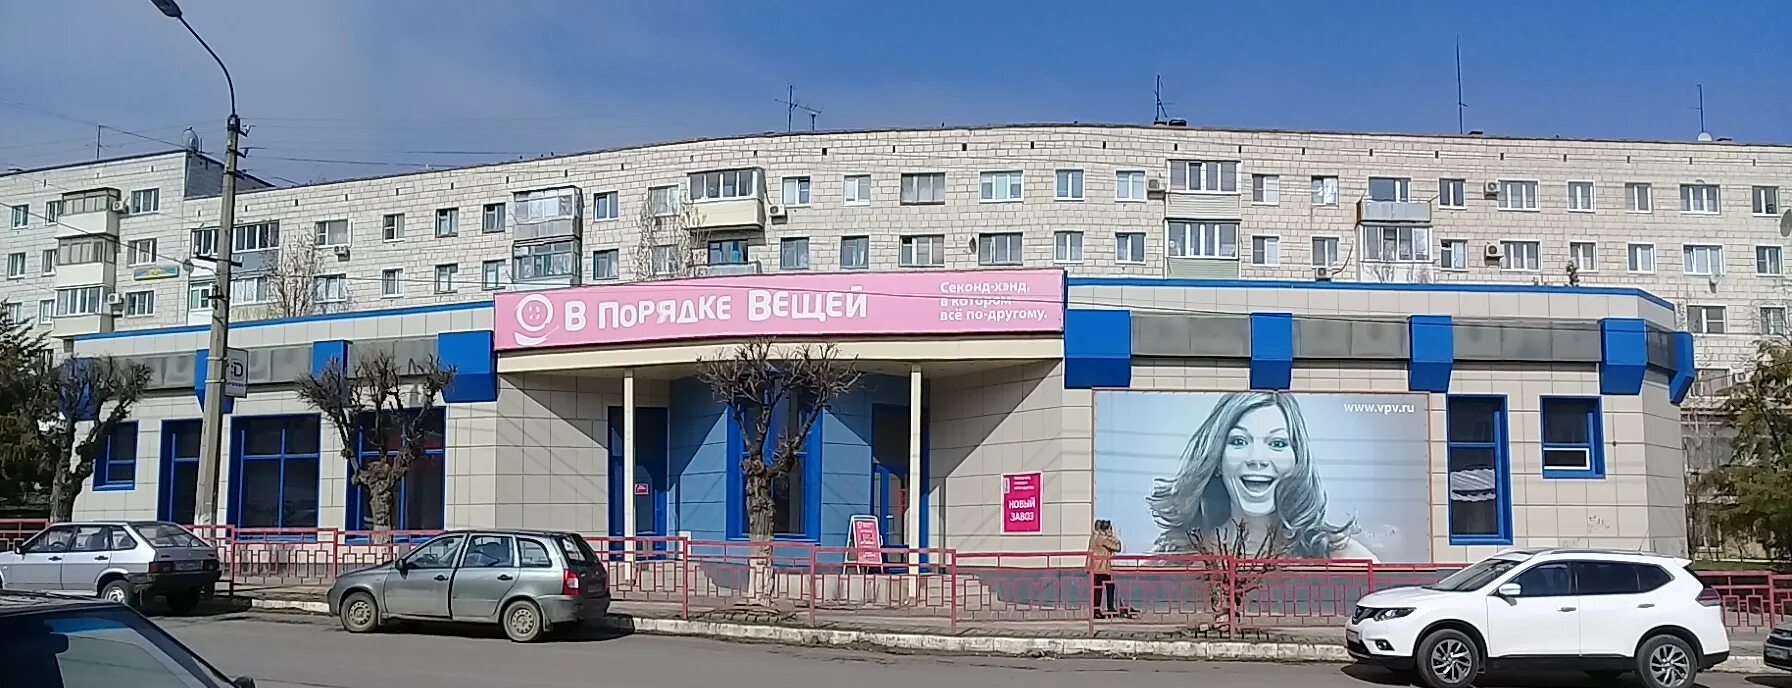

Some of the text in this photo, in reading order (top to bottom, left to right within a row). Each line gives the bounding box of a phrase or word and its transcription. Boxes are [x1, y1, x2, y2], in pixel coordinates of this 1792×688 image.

[940, 281, 1030, 293] Секонд-хэнд,
[940, 294, 1012, 308] в котором
[564, 300, 587, 332] В
[747, 285, 868, 322] ВЕЩЕЙ
[940, 308, 1048, 322] всё по-другому.
[1343, 403, 1415, 415] www.vpv.ru
[1008, 496, 1036, 509] НОВЫЙ
[1010, 511, 1035, 521] ЗАВОЗ
